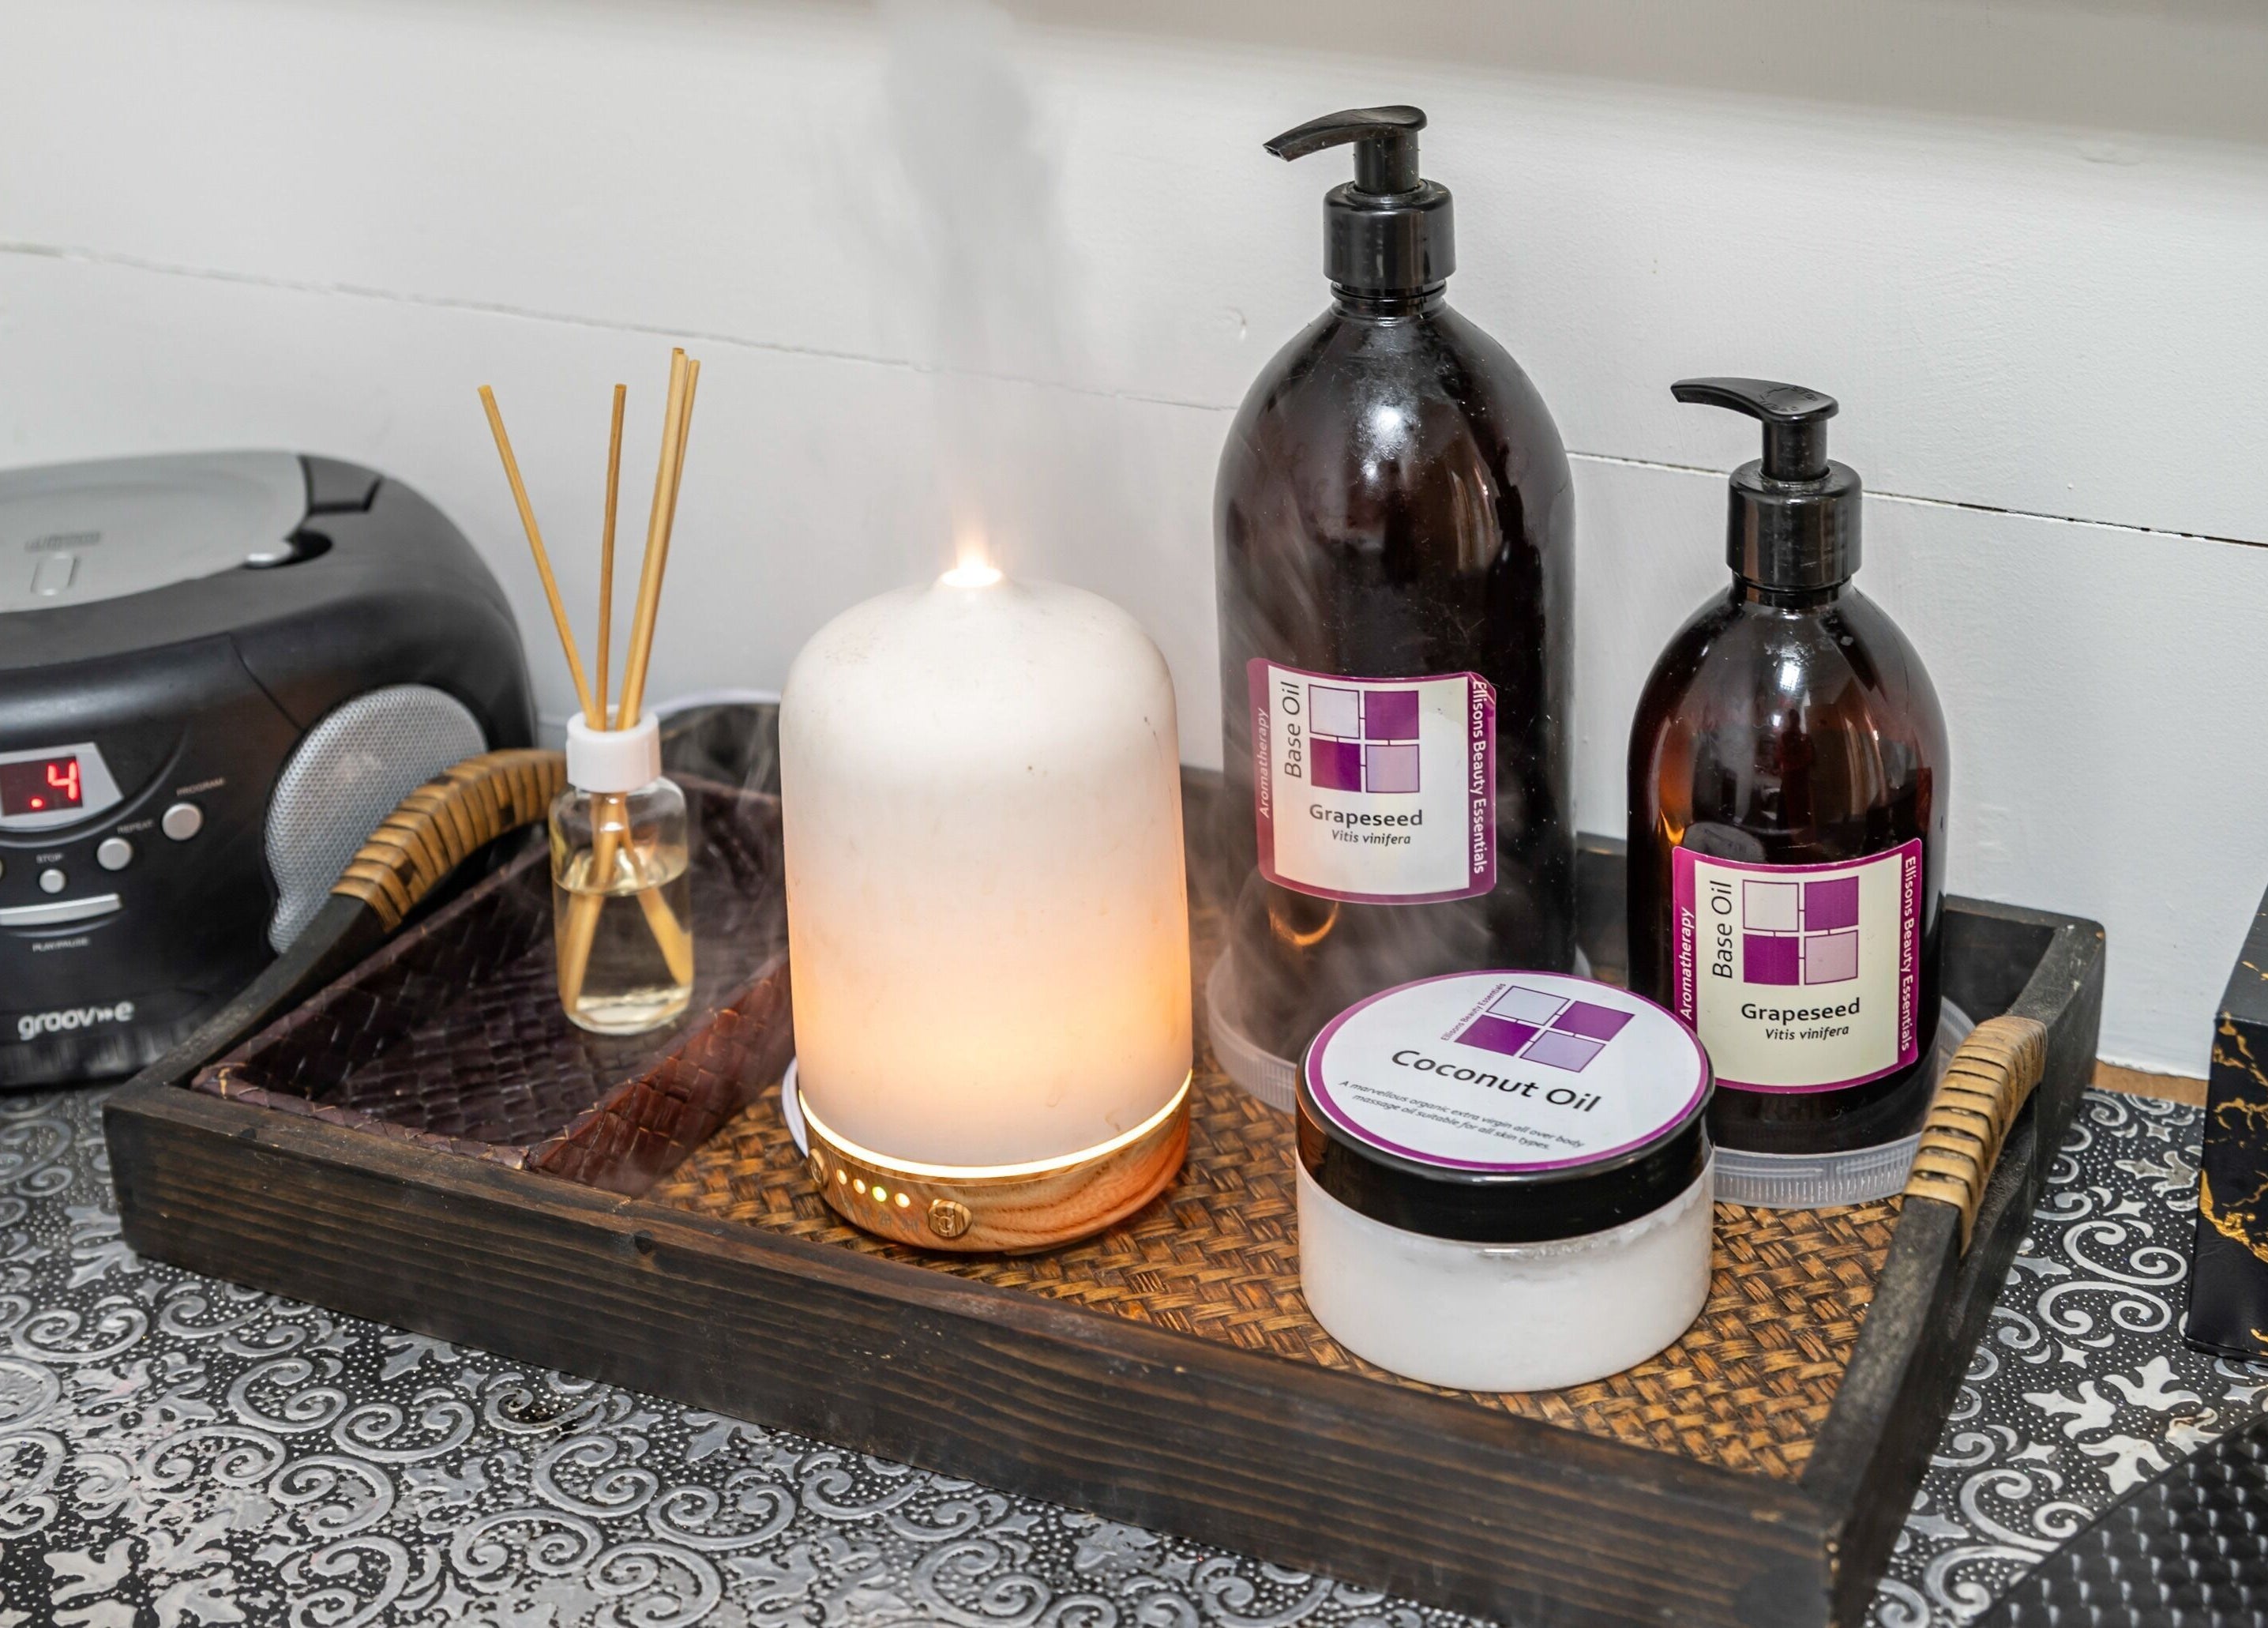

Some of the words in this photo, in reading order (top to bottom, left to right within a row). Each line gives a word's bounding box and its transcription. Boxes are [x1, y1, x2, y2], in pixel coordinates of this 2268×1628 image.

[1280, 681, 1300, 716] Oil
[1472, 681, 1488, 738] Ellisons
[1257, 708, 1270, 818] Aromatherapy
[1284, 723, 1302, 778] Base
[1470, 740, 1486, 795] Beauty
[1309, 803, 1423, 828] Grapeseed
[1331, 829, 1359, 844] Vitis
[1362, 833, 1411, 847] vinifera
[1472, 798, 1488, 874] Essentials
[36, 852, 63, 864] STOP
[1710, 880, 1733, 916] Oil
[1904, 855, 1917, 917] Ellisons
[1679, 906, 1695, 1021] Aromatherapy
[1712, 923, 1733, 979] Base
[1900, 917, 1915, 973] Beauty
[1459, 1005, 1483, 1023] Beauty
[1478, 983, 1507, 1006] Essentials
[1740, 997, 1861, 1025] Grapeseed
[1901, 974, 1913, 1051] Essentials
[1765, 1028, 1795, 1040] Vitis
[1799, 1025, 1849, 1040] vinifera
[1391, 1050, 1539, 1097] Coconut
[1545, 1088, 1601, 1113] Oil
[1350, 1083, 1409, 1102] marvellous
[1409, 1099, 1451, 1113] organic
[1451, 1108, 1480, 1121] extra
[1481, 1116, 1512, 1129] virgin
[1513, 1125, 1530, 1134] all
[1530, 1130, 1555, 1140] over
[1555, 1135, 1586, 1148] body
[1352, 1094, 1401, 1111] massage
[1401, 1107, 1417, 1115] oil
[1416, 1111, 1460, 1126] suitable
[1457, 1120, 1479, 1130] for
[1478, 1126, 1496, 1135] all
[1494, 1130, 1517, 1140] skin
